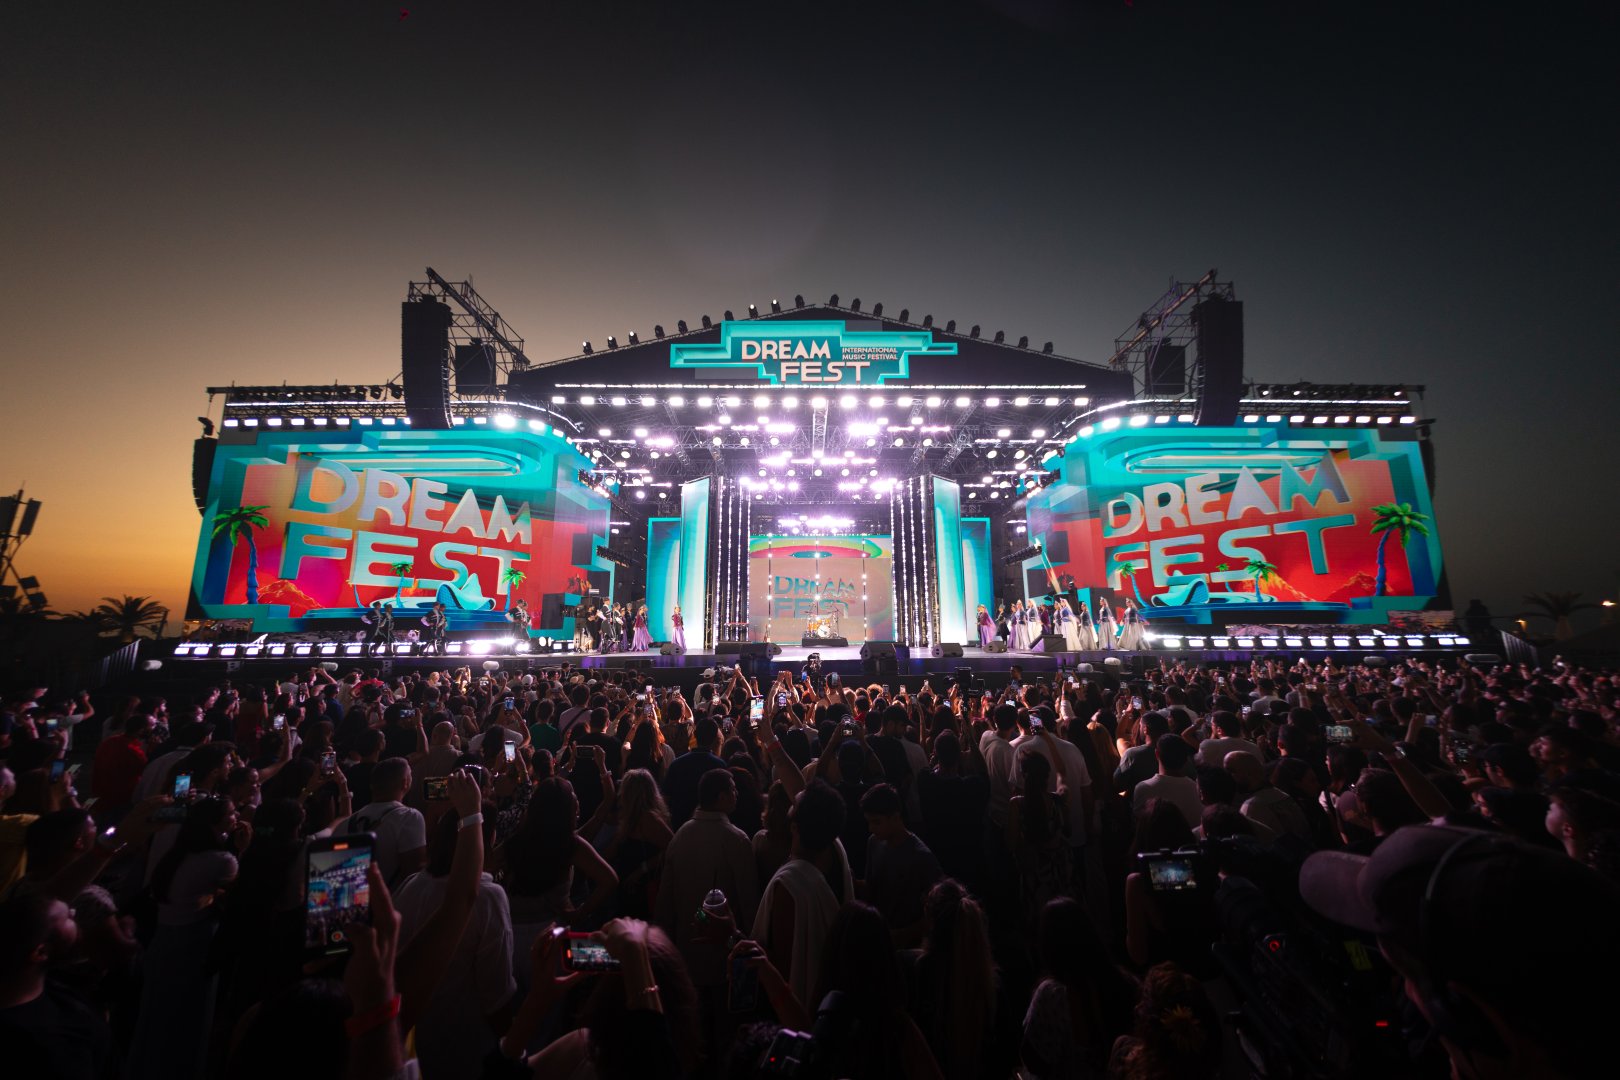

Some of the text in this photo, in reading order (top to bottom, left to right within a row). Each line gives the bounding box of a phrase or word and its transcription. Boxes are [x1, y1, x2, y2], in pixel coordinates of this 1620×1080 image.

[742, 340, 831, 360] DREAM
[781, 362, 870, 382] FEST
[289, 457, 532, 544] DREAM
[1102, 450, 1352, 538] DREAM
[278, 521, 531, 595] FEST
[1104, 514, 1356, 590] FEST
